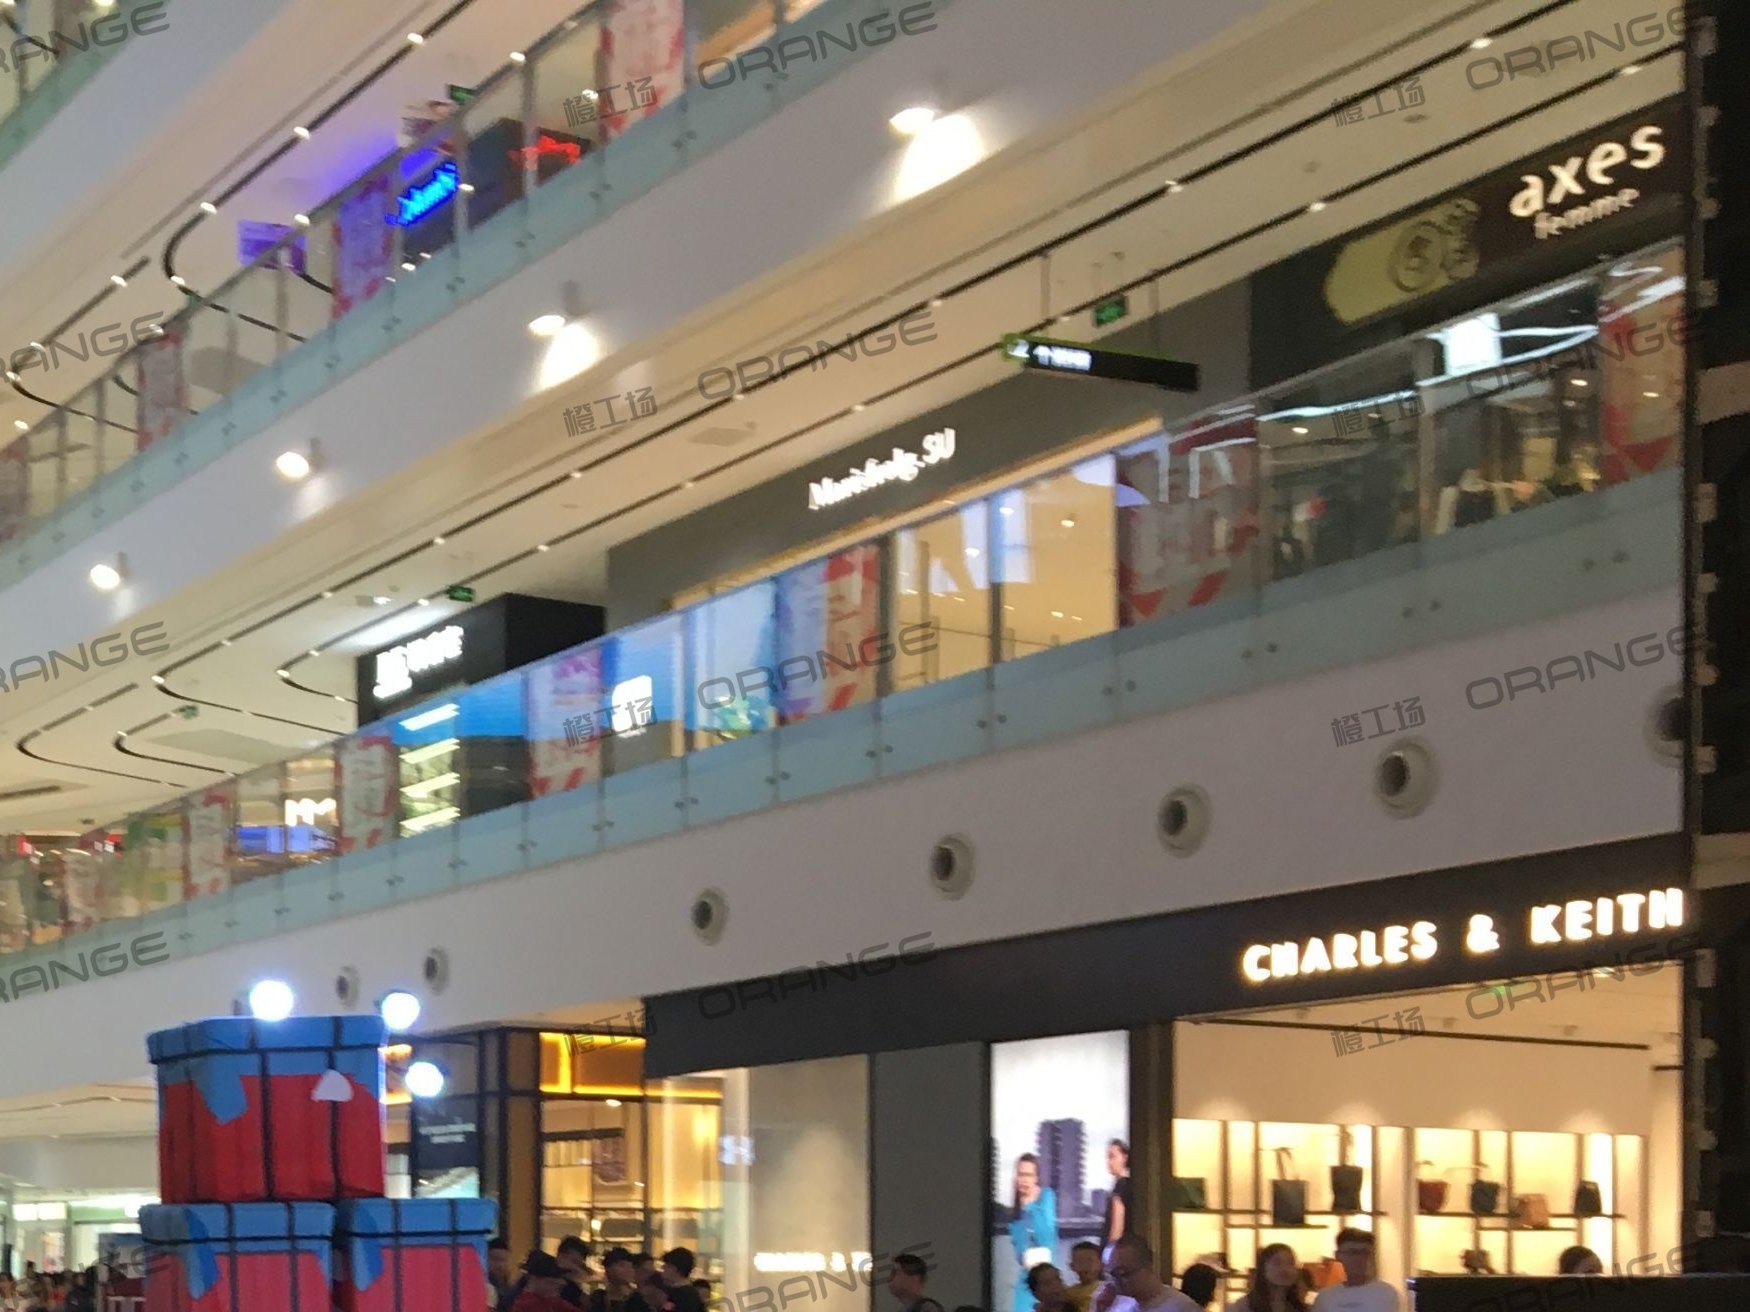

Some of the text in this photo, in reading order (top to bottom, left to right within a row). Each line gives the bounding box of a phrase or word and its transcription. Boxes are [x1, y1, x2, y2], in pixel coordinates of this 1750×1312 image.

[1509, 125, 1666, 218] axes
[1242, 886, 1684, 982] CHARLES & KEITH
